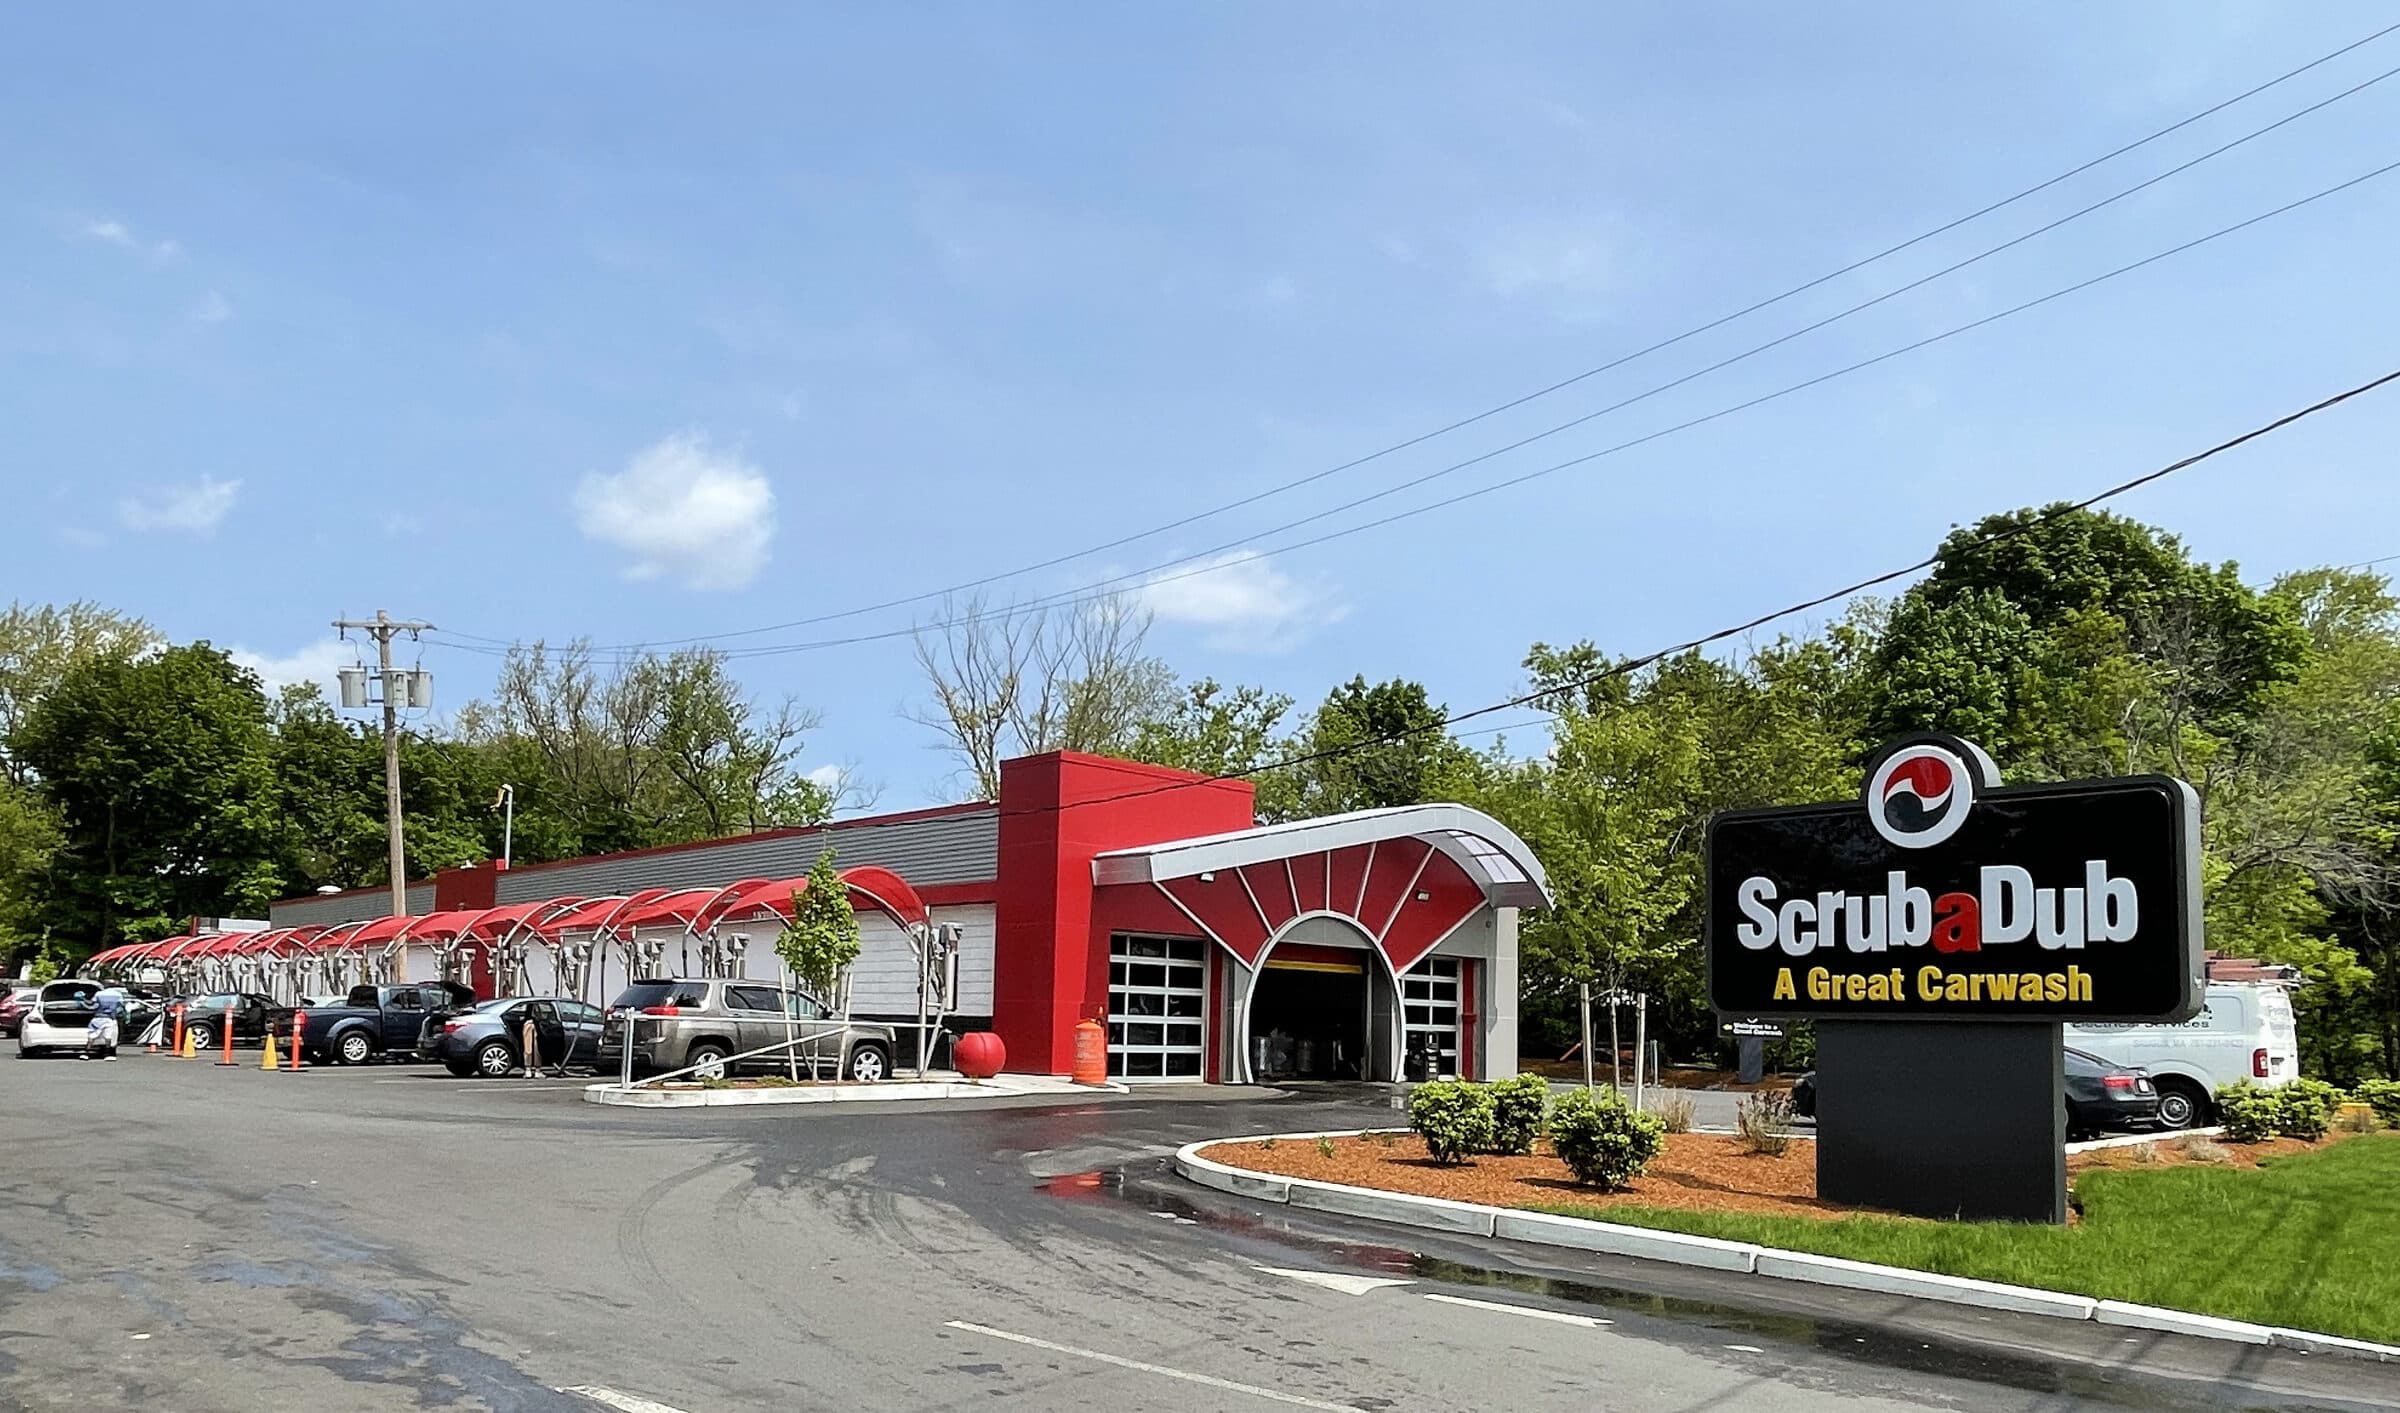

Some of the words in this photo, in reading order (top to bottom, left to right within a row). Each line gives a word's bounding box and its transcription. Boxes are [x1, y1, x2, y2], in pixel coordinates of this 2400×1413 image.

[1737, 860, 2138, 956] ScrubaDub
[1773, 968, 1796, 1000] A
[1807, 967, 1904, 1000] Great
[1918, 965, 2093, 1001] Carwash
